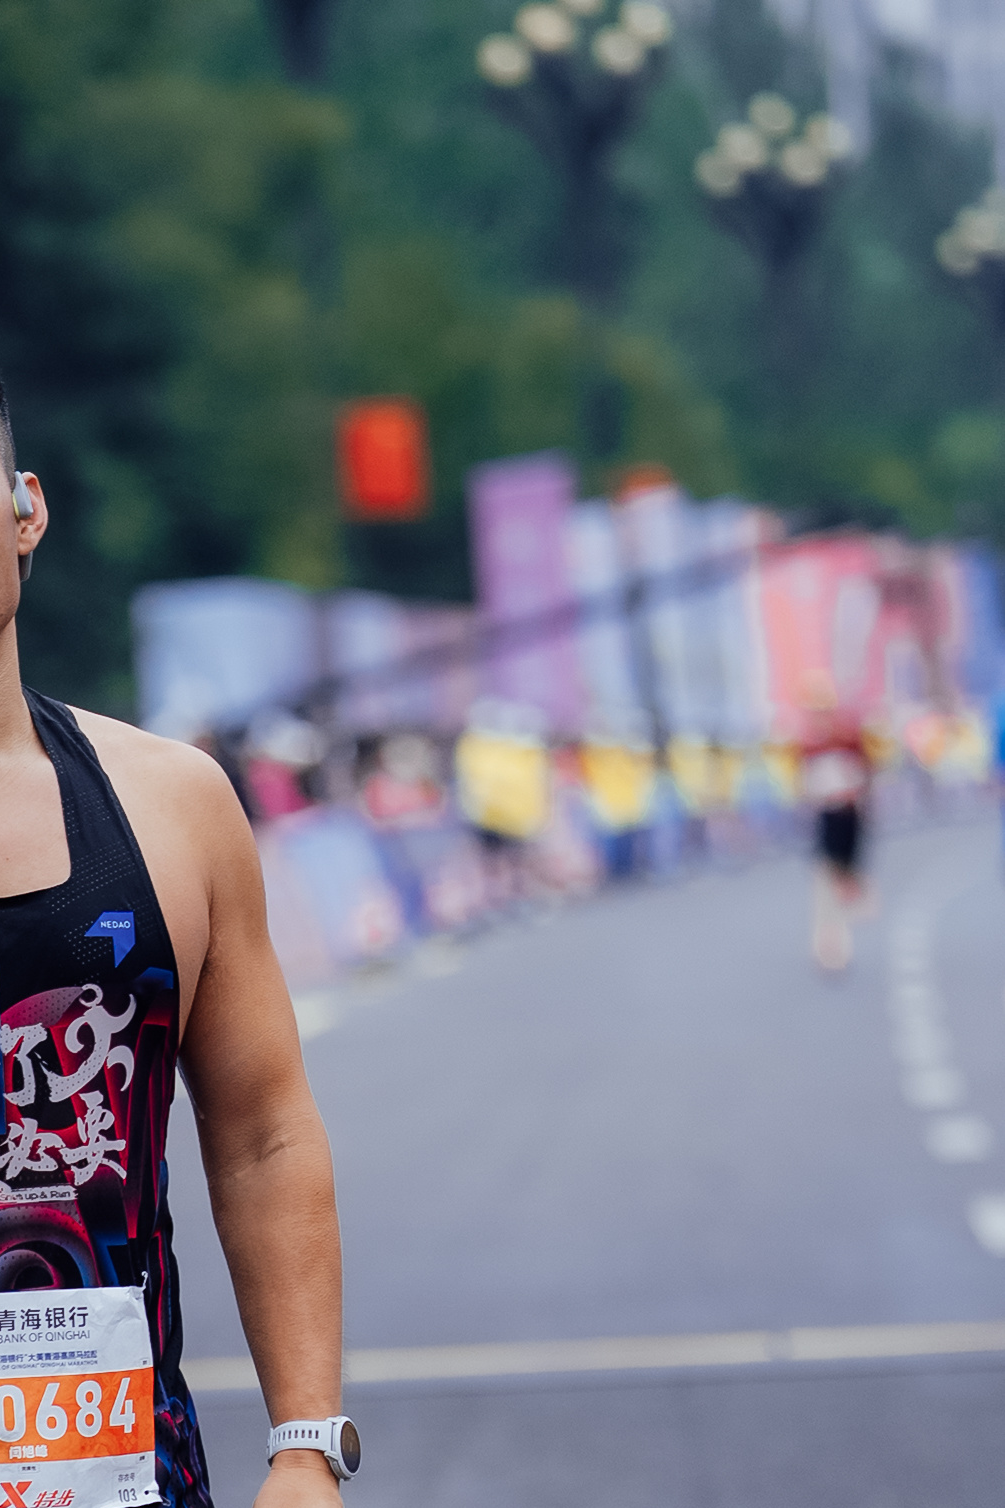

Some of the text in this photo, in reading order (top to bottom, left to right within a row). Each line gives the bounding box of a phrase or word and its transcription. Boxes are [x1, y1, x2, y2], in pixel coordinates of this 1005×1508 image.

[100, 920, 131, 929] NEDAO
[28, 1332, 43, 1343] OF
[45, 1330, 91, 1342] QINGHAI
[30, 1489, 76, 1508] 特步
[118, 1488, 138, 1503] 103
